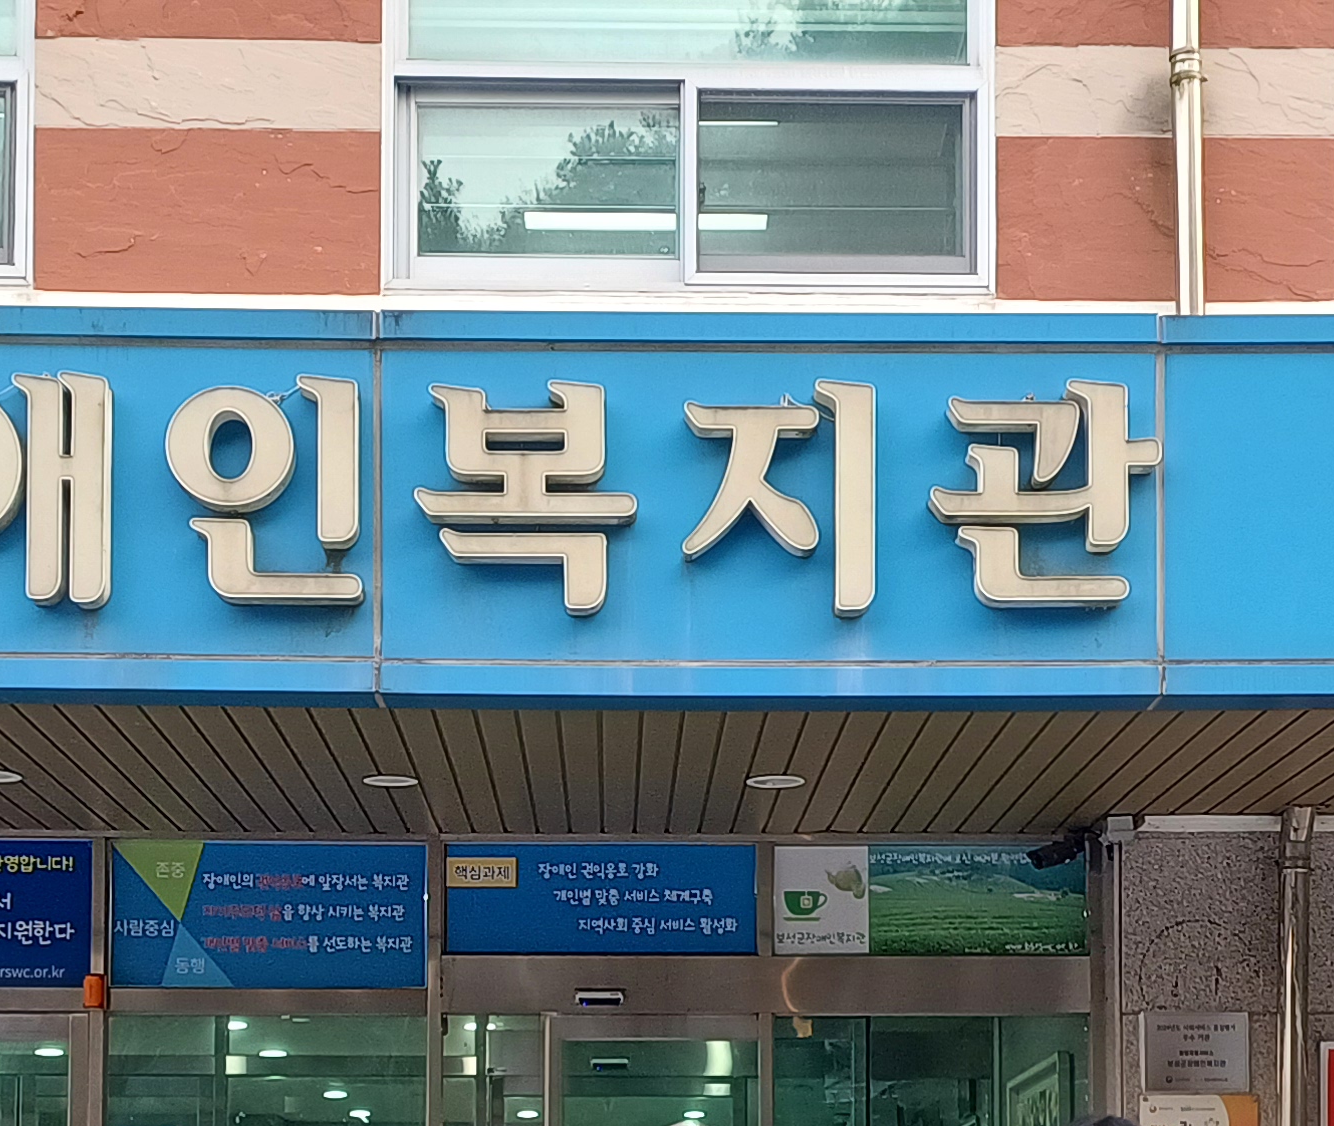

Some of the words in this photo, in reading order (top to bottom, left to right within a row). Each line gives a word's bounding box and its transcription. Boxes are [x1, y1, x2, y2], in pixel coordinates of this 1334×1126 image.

[155, 861, 186, 879] 존중
[454, 864, 510, 881] 핵심과제
[538, 862, 577, 880] 장애인
[581, 862, 629, 880] 권익옹호
[631, 863, 659, 880] 강화
[203, 872, 254, 890] 장애인의
[318, 873, 368, 891] 앞장서는
[372, 873, 409, 891] 복지관
[553, 888, 592, 906] 개인별
[595, 888, 620, 906] 맞춤
[624, 889, 660, 903] 서비스
[297, 903, 325, 922] 향상
[328, 904, 365, 922] 시키는
[368, 904, 405, 921] 복지관
[113, 919, 175, 937] 사람중심
[578, 917, 628, 935] 지역사회
[631, 917, 656, 935] 중심
[659, 918, 696, 931] 서비스
[323, 936, 372, 954] 선도하는
[376, 936, 413, 954] 복지관
[175, 957, 205, 974] 동행
